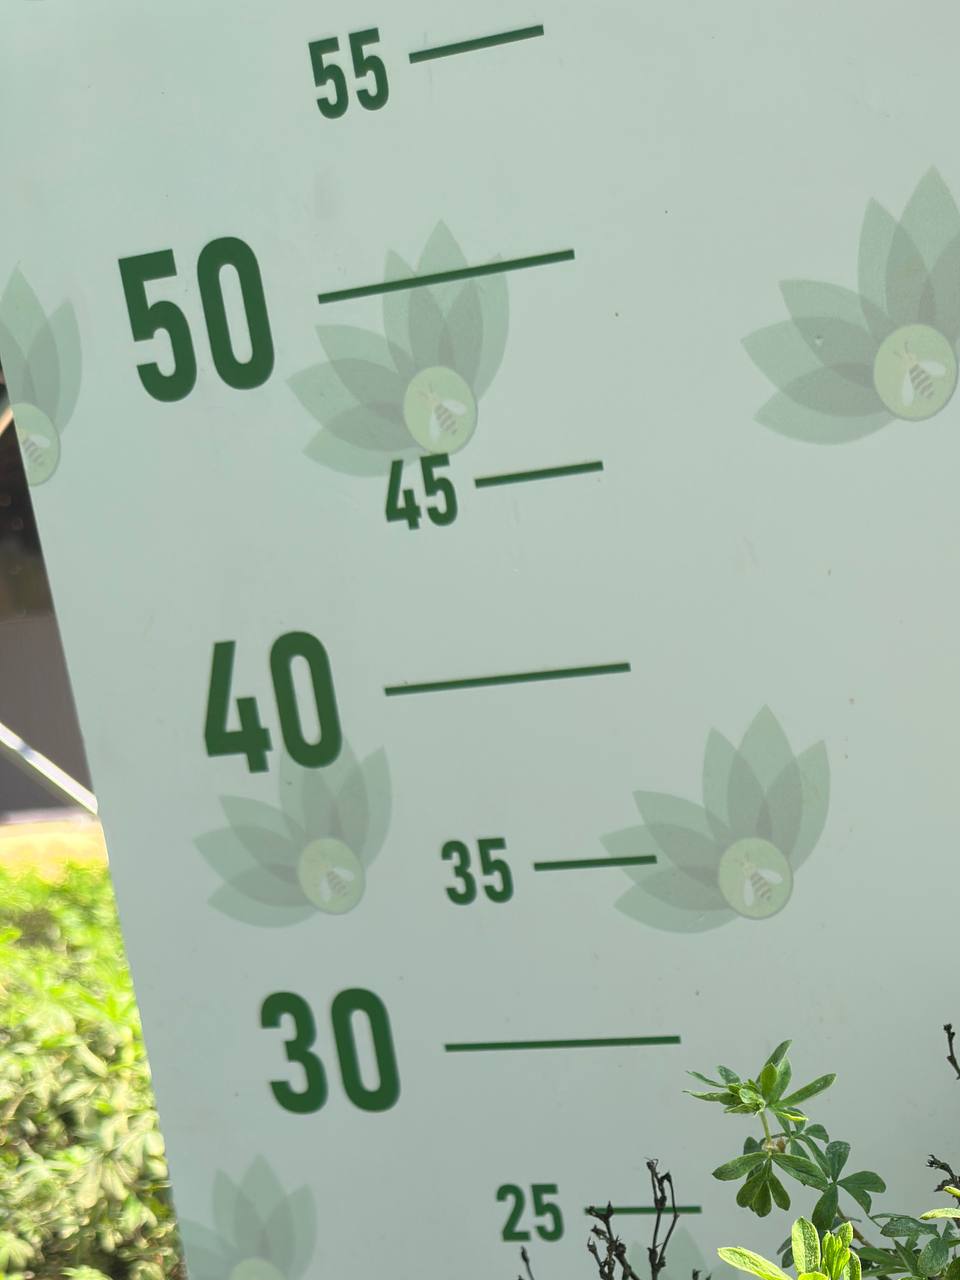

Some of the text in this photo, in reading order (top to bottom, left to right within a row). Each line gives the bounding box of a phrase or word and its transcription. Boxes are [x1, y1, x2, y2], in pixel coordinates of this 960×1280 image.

[308, 27, 390, 119] 55
[117, 236, 275, 403] 50
[385, 452, 459, 530] 45
[203, 630, 343, 774] 40
[440, 837, 514, 906] 35
[260, 987, 401, 1115] 30
[495, 1183, 564, 1243] 25
